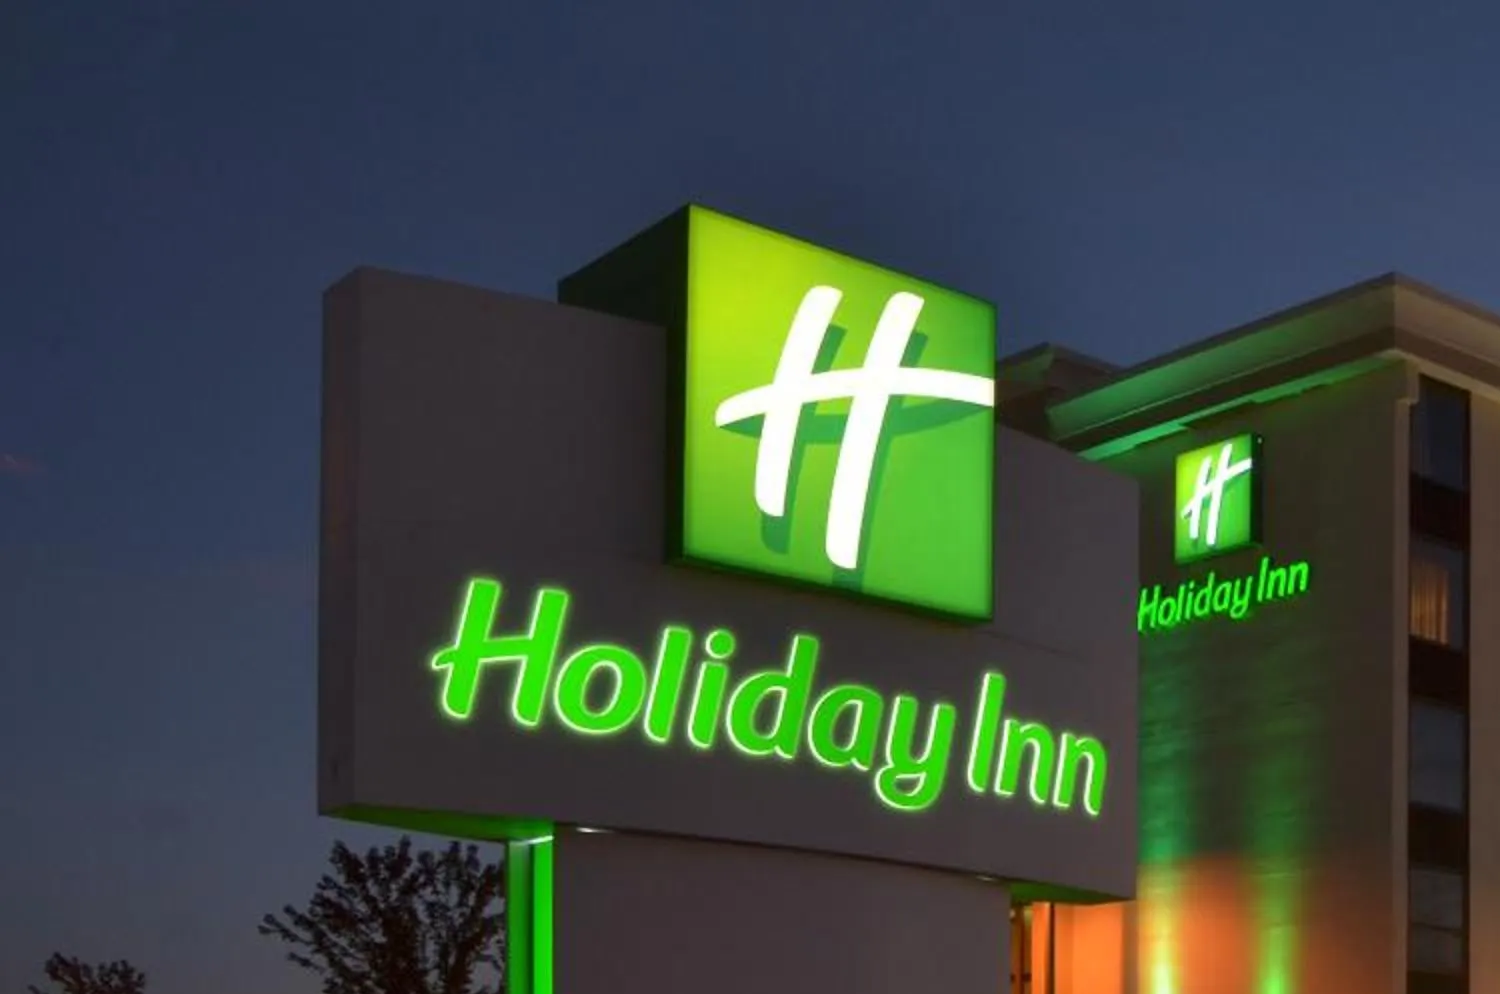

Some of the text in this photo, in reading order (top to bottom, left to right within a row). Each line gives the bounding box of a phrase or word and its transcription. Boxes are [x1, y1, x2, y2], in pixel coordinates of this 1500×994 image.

[714, 285, 996, 569] H
[431, 576, 1109, 816] Holiday Inn
[1137, 556, 1309, 632] Holiday Inn
